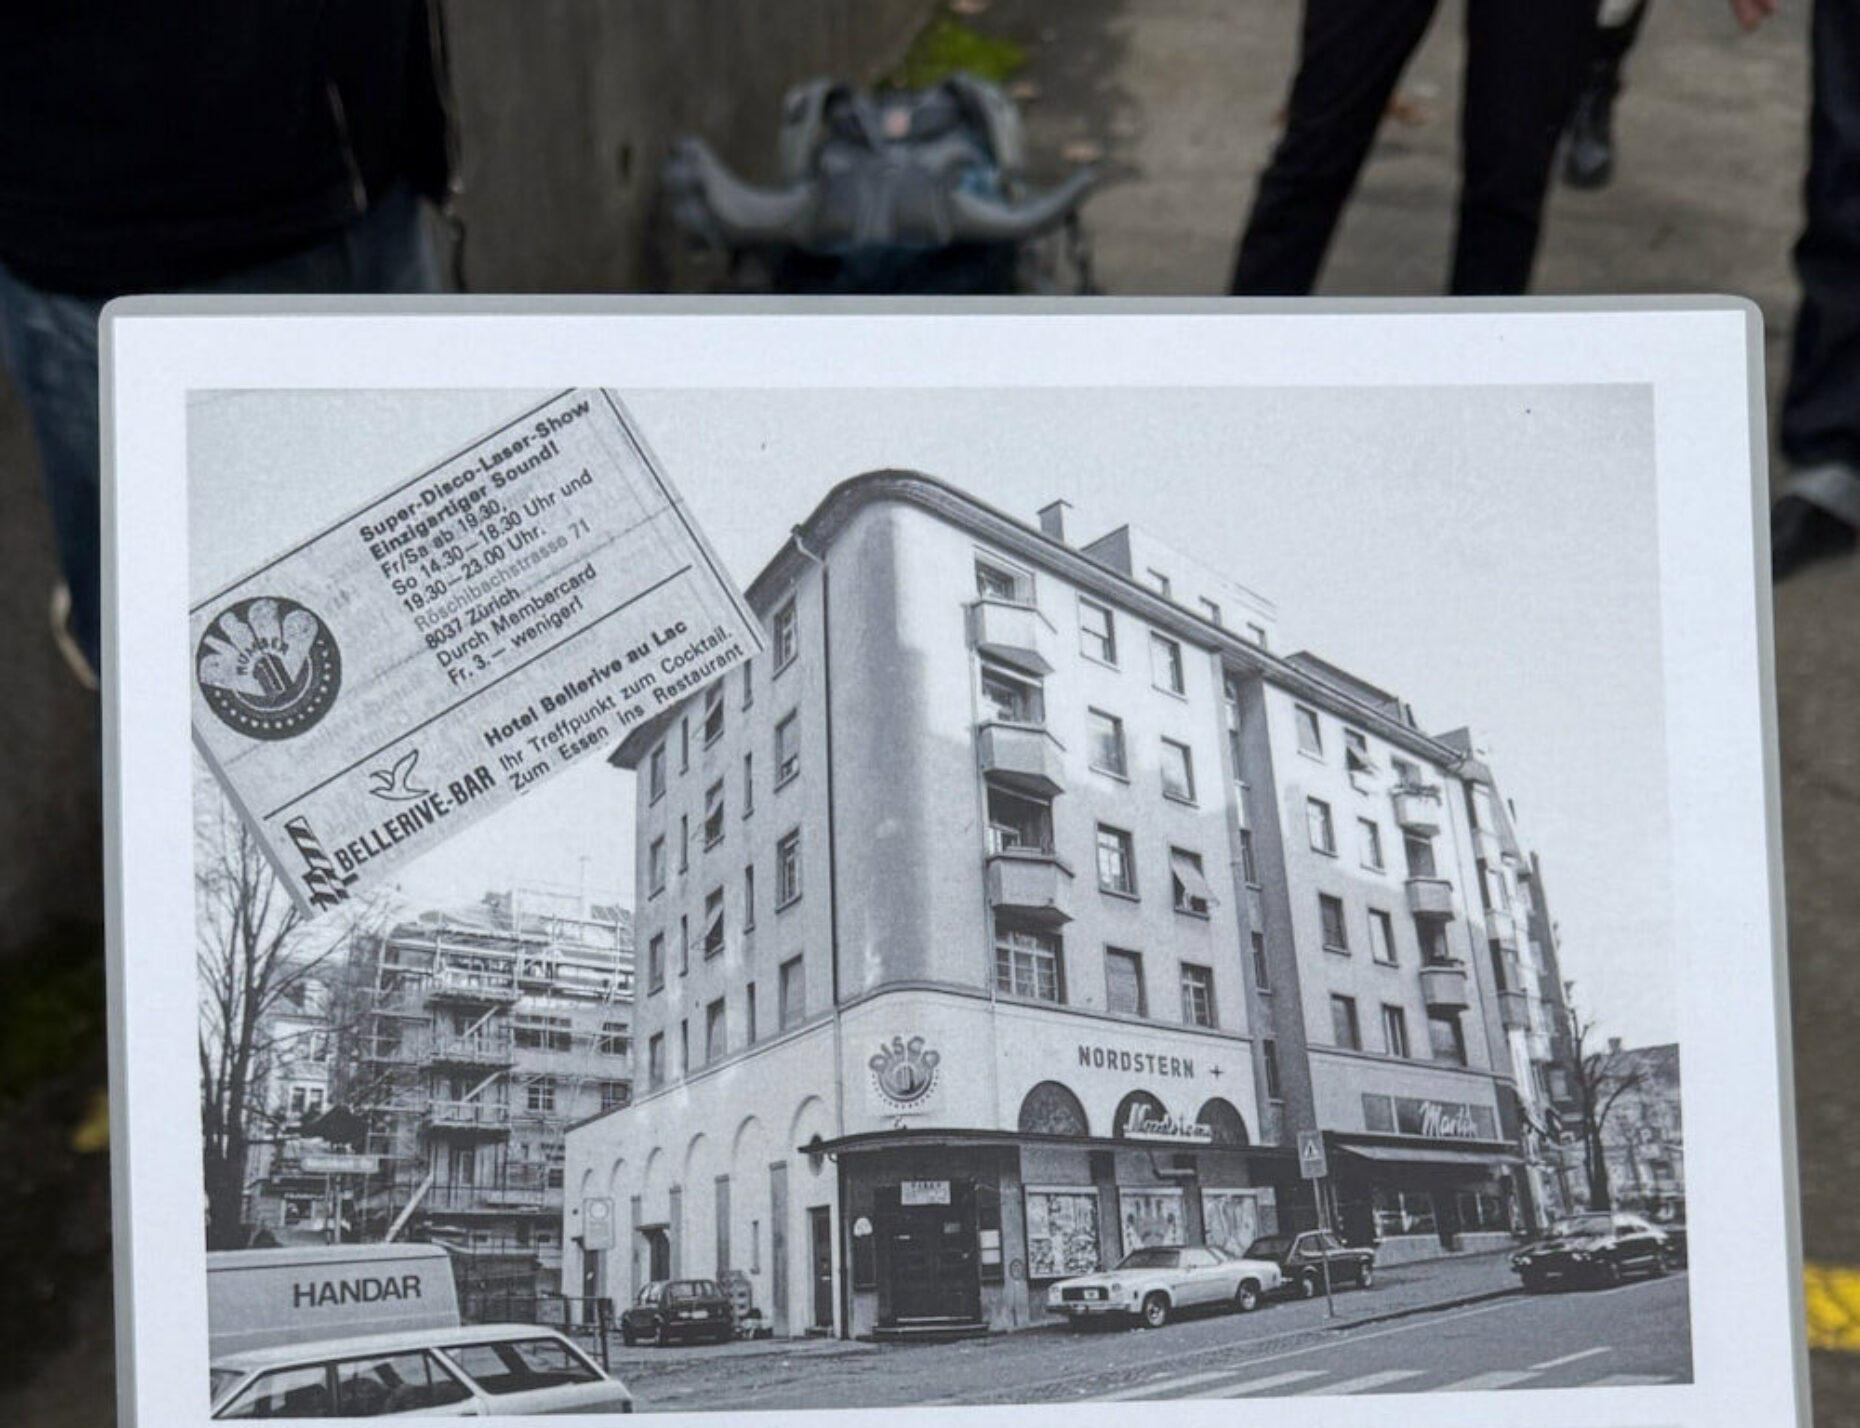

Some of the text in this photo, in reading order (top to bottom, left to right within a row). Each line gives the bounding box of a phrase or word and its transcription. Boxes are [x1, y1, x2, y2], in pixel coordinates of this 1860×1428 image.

[359, 400, 591, 543] Super-Disco-Laser-Show
[369, 440, 560, 561] Einzigartiger Sound!
[381, 543, 430, 579] Fr/Sa
[432, 527, 454, 549] ab
[391, 575, 418, 597] So
[523, 492, 558, 517] Uhr
[560, 467, 594, 497] und
[414, 517, 591, 633] Röschibachstrasse 71
[507, 524, 547, 552] Uhr.
[425, 586, 521, 650] 8037 Zürich
[436, 562, 598, 668] Durch Membercard
[447, 665, 473, 687] Fr.
[511, 595, 585, 650] weniger!
[483, 618, 689, 748] Hotel Bellerive au Lac
[500, 625, 732, 772] Ihr Treffpunkt zum Cocktail.
[509, 642, 744, 791] Zum Essen ins Restaurant
[333, 765, 496, 873] BELLERIVE-BAR
[1078, 1045, 1195, 1079] NORDSTERN
[293, 1274, 422, 1309] HANDAR
